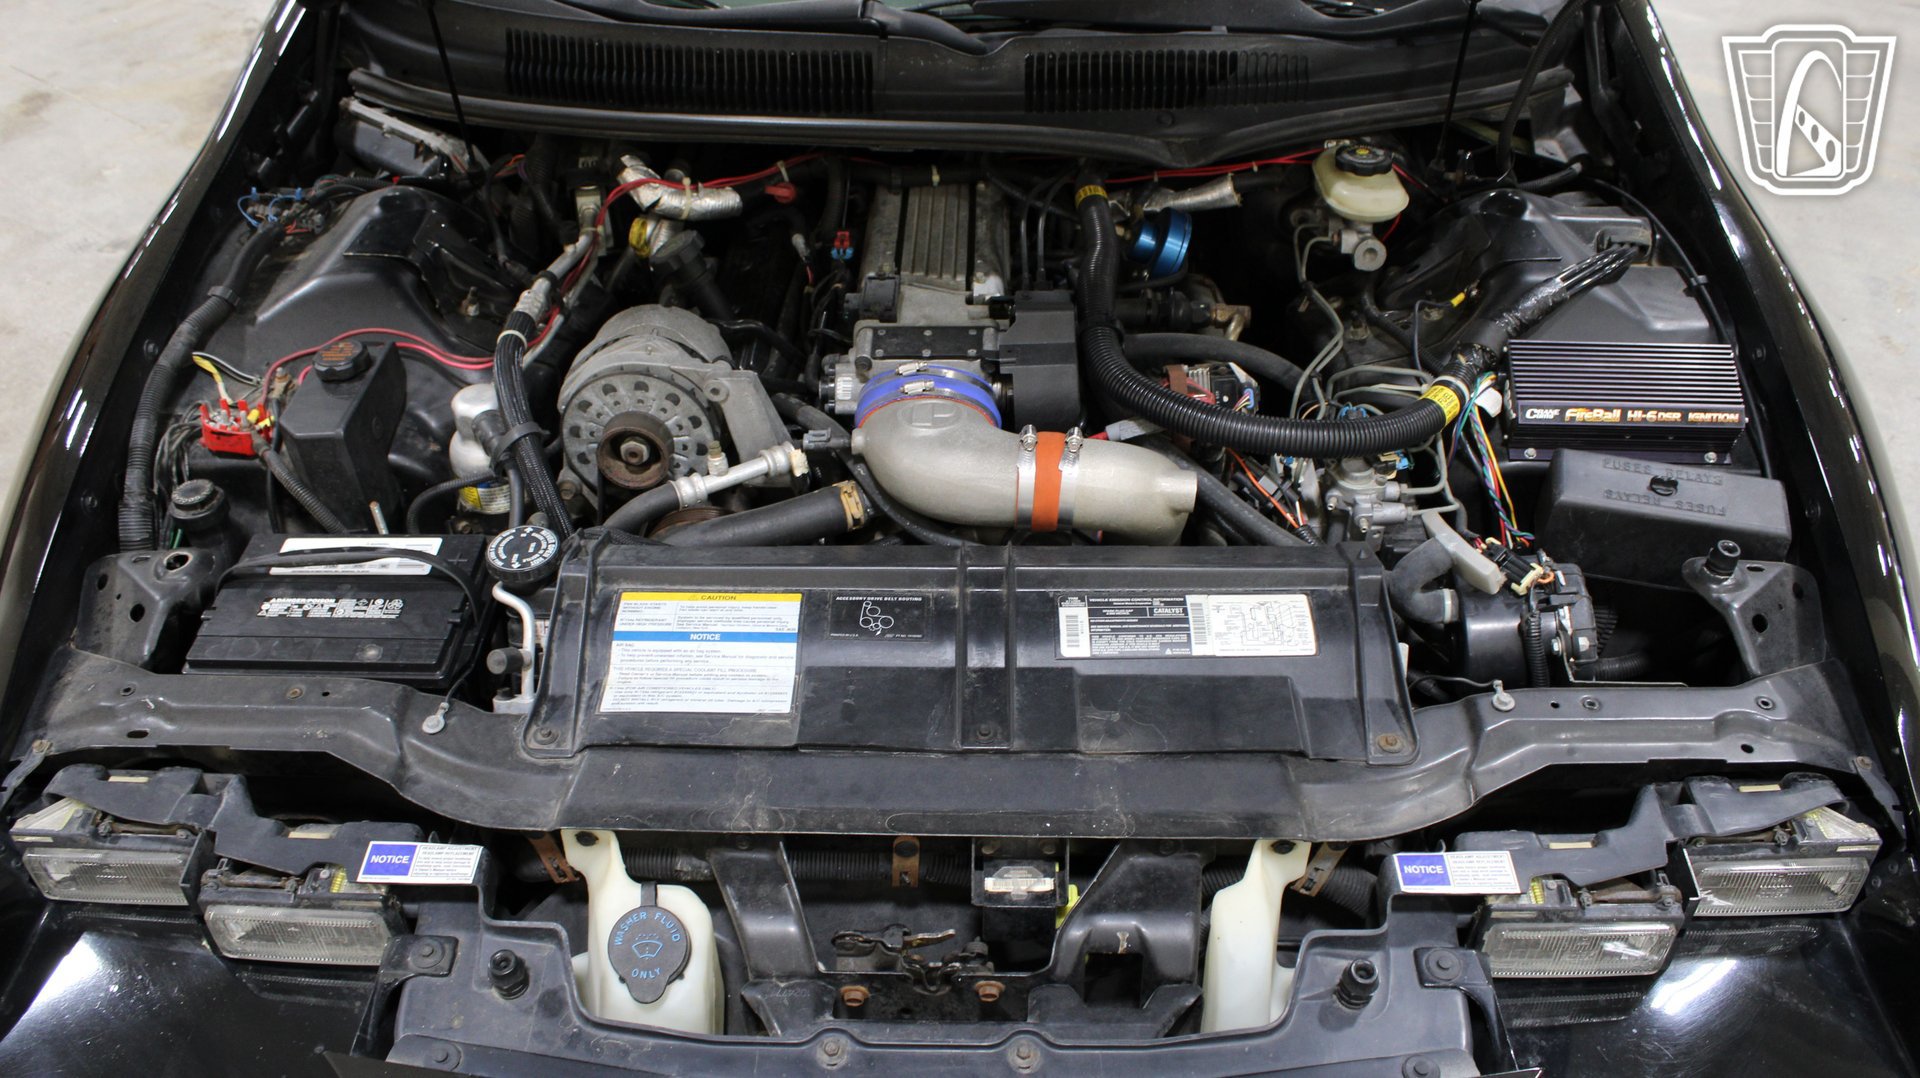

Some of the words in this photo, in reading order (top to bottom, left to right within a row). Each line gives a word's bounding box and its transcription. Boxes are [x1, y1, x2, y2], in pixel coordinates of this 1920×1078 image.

[1565, 408, 1622, 422] FireBall
[1688, 412, 1740, 422] IGNITION
[1602, 457, 1650, 474] FUSES
[1667, 469, 1723, 486] RELAYS
[1604, 488, 1661, 506] RELAYS
[1676, 500, 1726, 516] FUSES
[370, 855, 410, 864] NOTICE
[1404, 865, 1444, 874] NOTICE
[614, 912, 647, 945] WASHER
[654, 912, 680, 942] FLUID
[631, 968, 661, 979] ONLY
